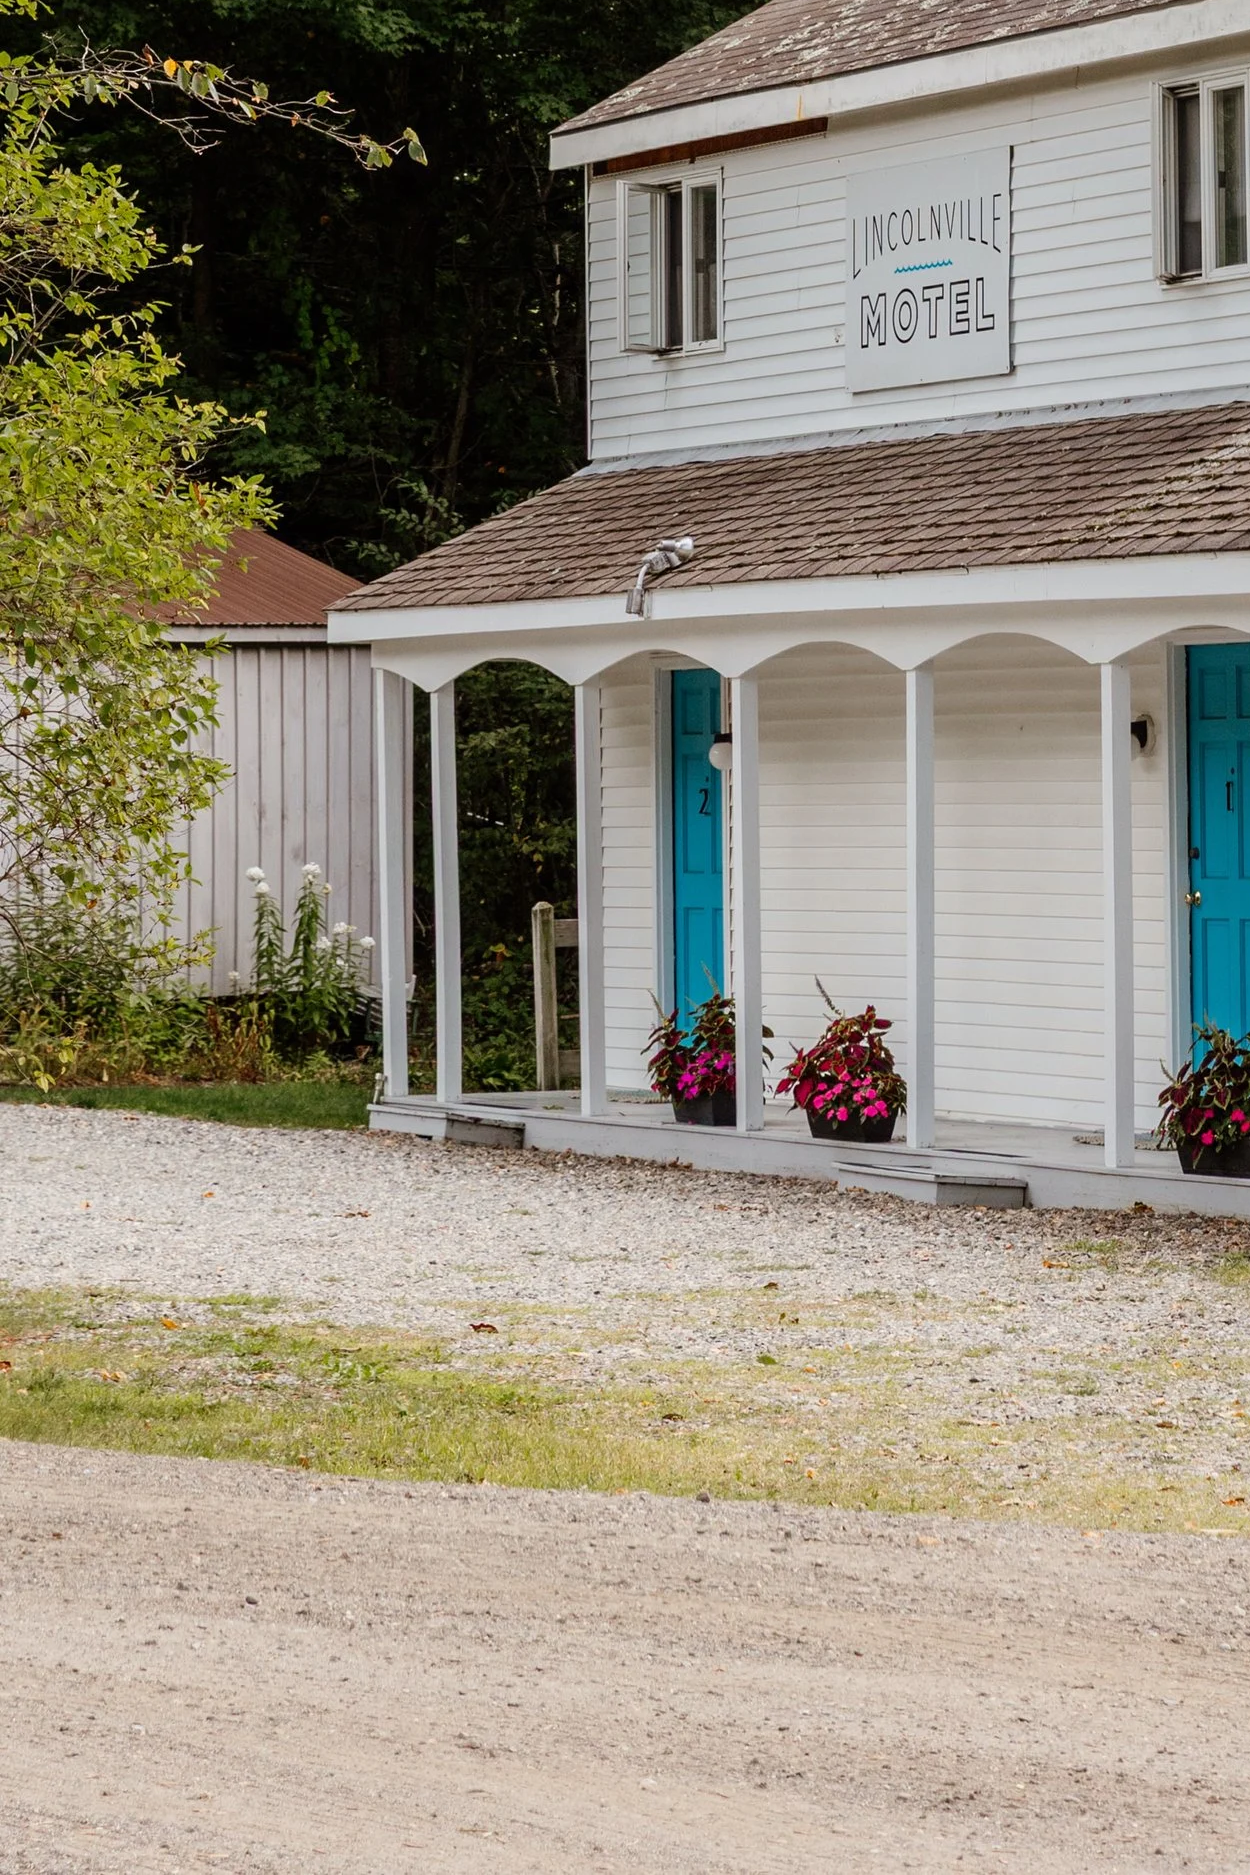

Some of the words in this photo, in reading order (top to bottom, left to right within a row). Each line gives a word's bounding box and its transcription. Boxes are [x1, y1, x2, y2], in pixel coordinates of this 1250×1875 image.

[852, 193, 1001, 280] LINCOLNVILLE
[861, 277, 995, 349] MOTEL
[699, 788, 711, 816] 2
